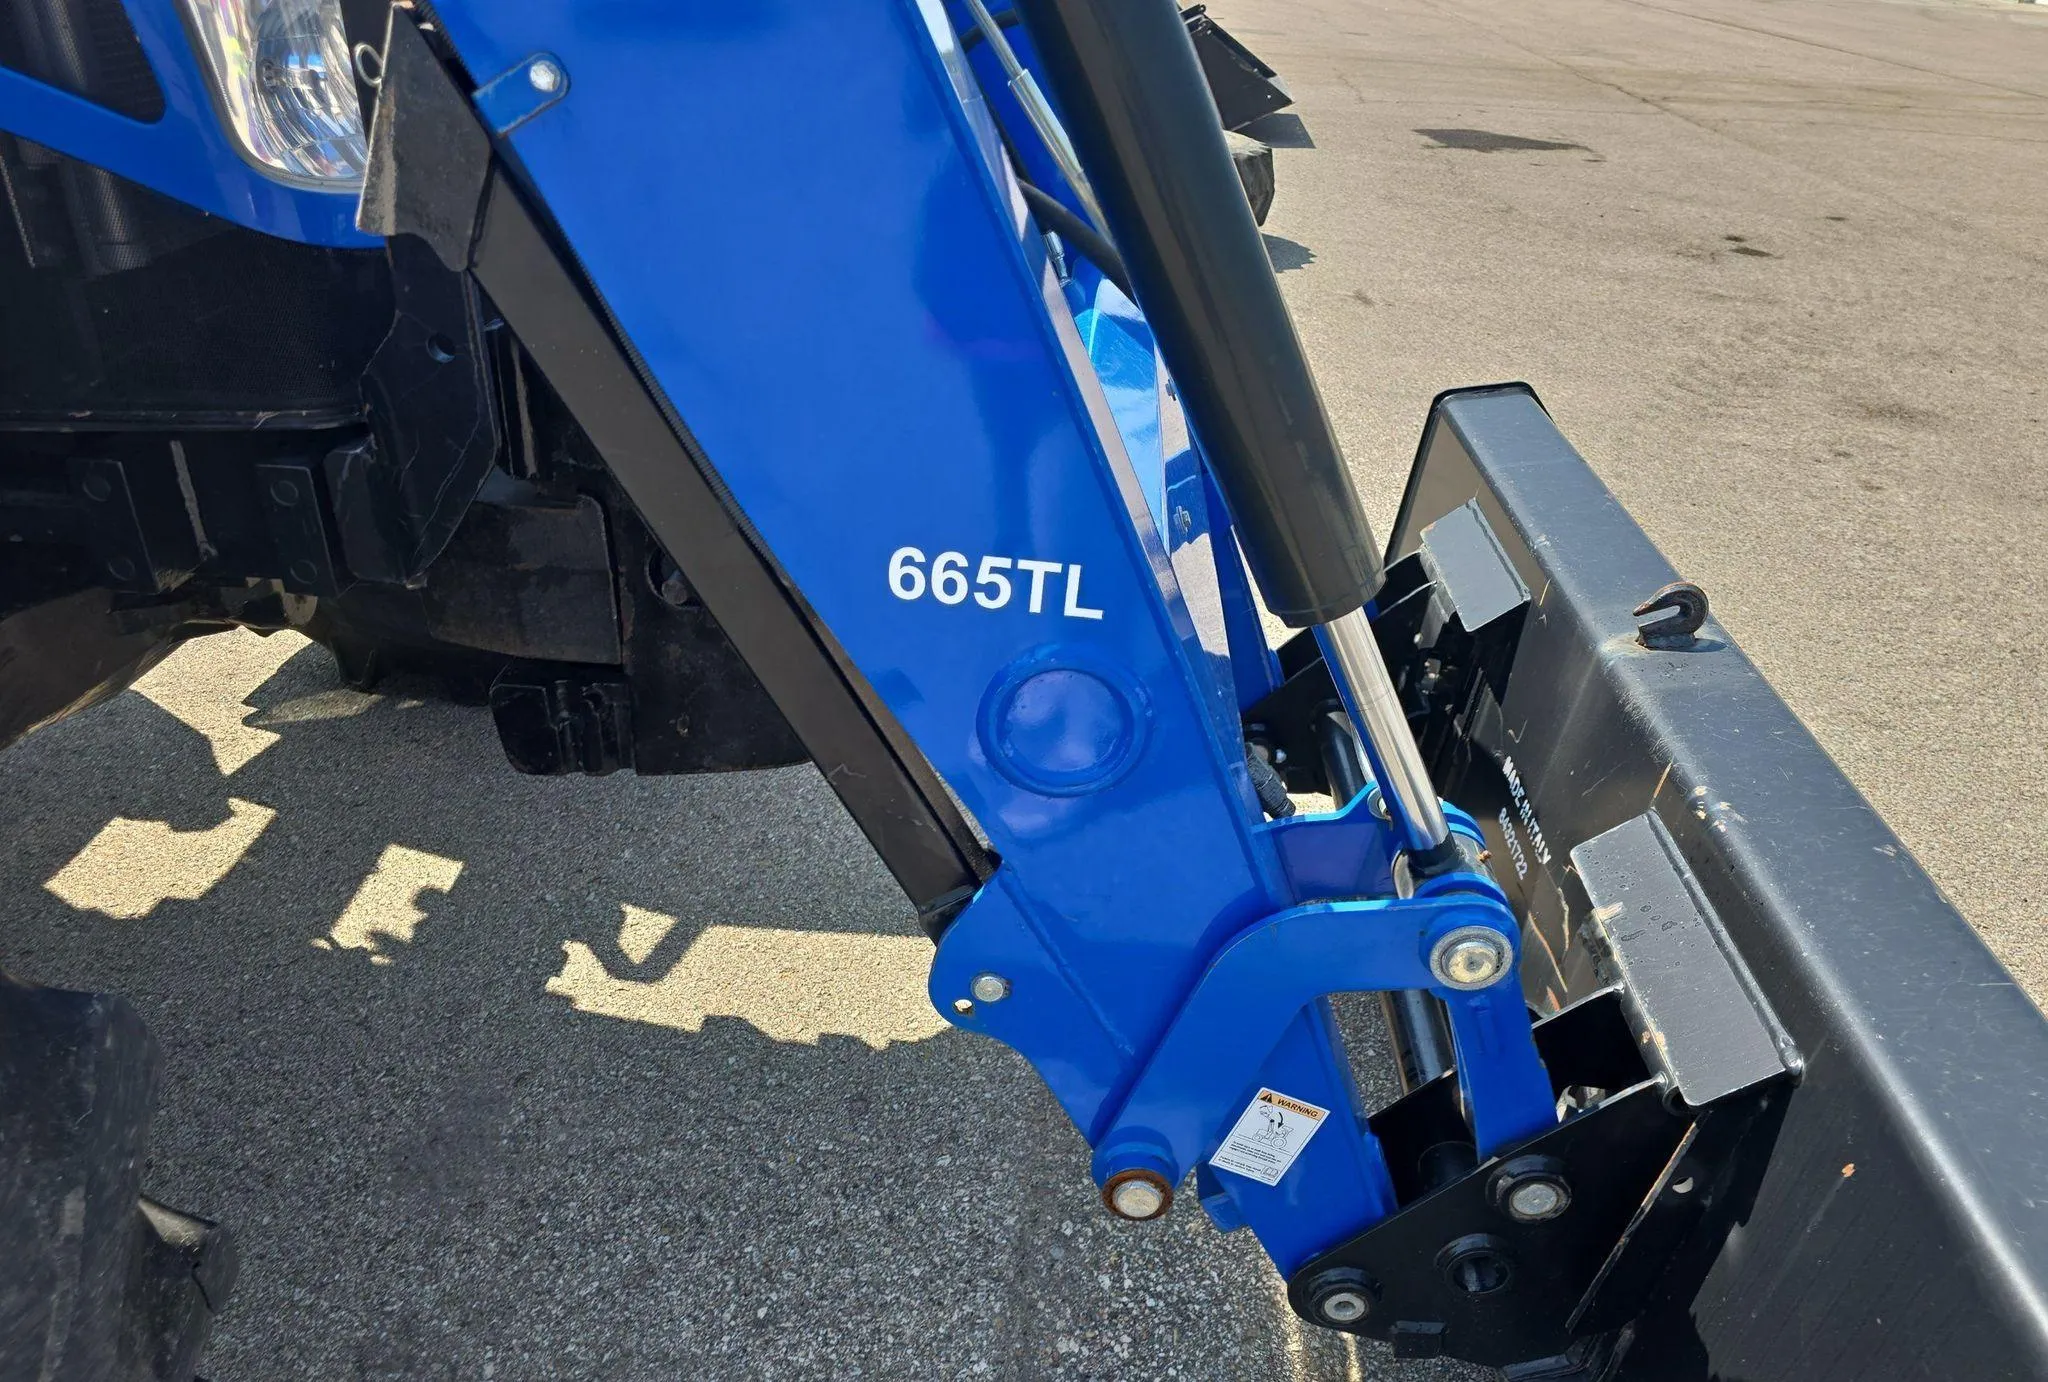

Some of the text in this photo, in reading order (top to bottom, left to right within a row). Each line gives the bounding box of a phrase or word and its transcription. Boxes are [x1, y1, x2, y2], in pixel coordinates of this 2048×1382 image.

[888, 546, 1104, 620] 665TL
[1502, 755, 1552, 865] MADE IN ITALY
[1277, 1098, 1319, 1118] WARNING
